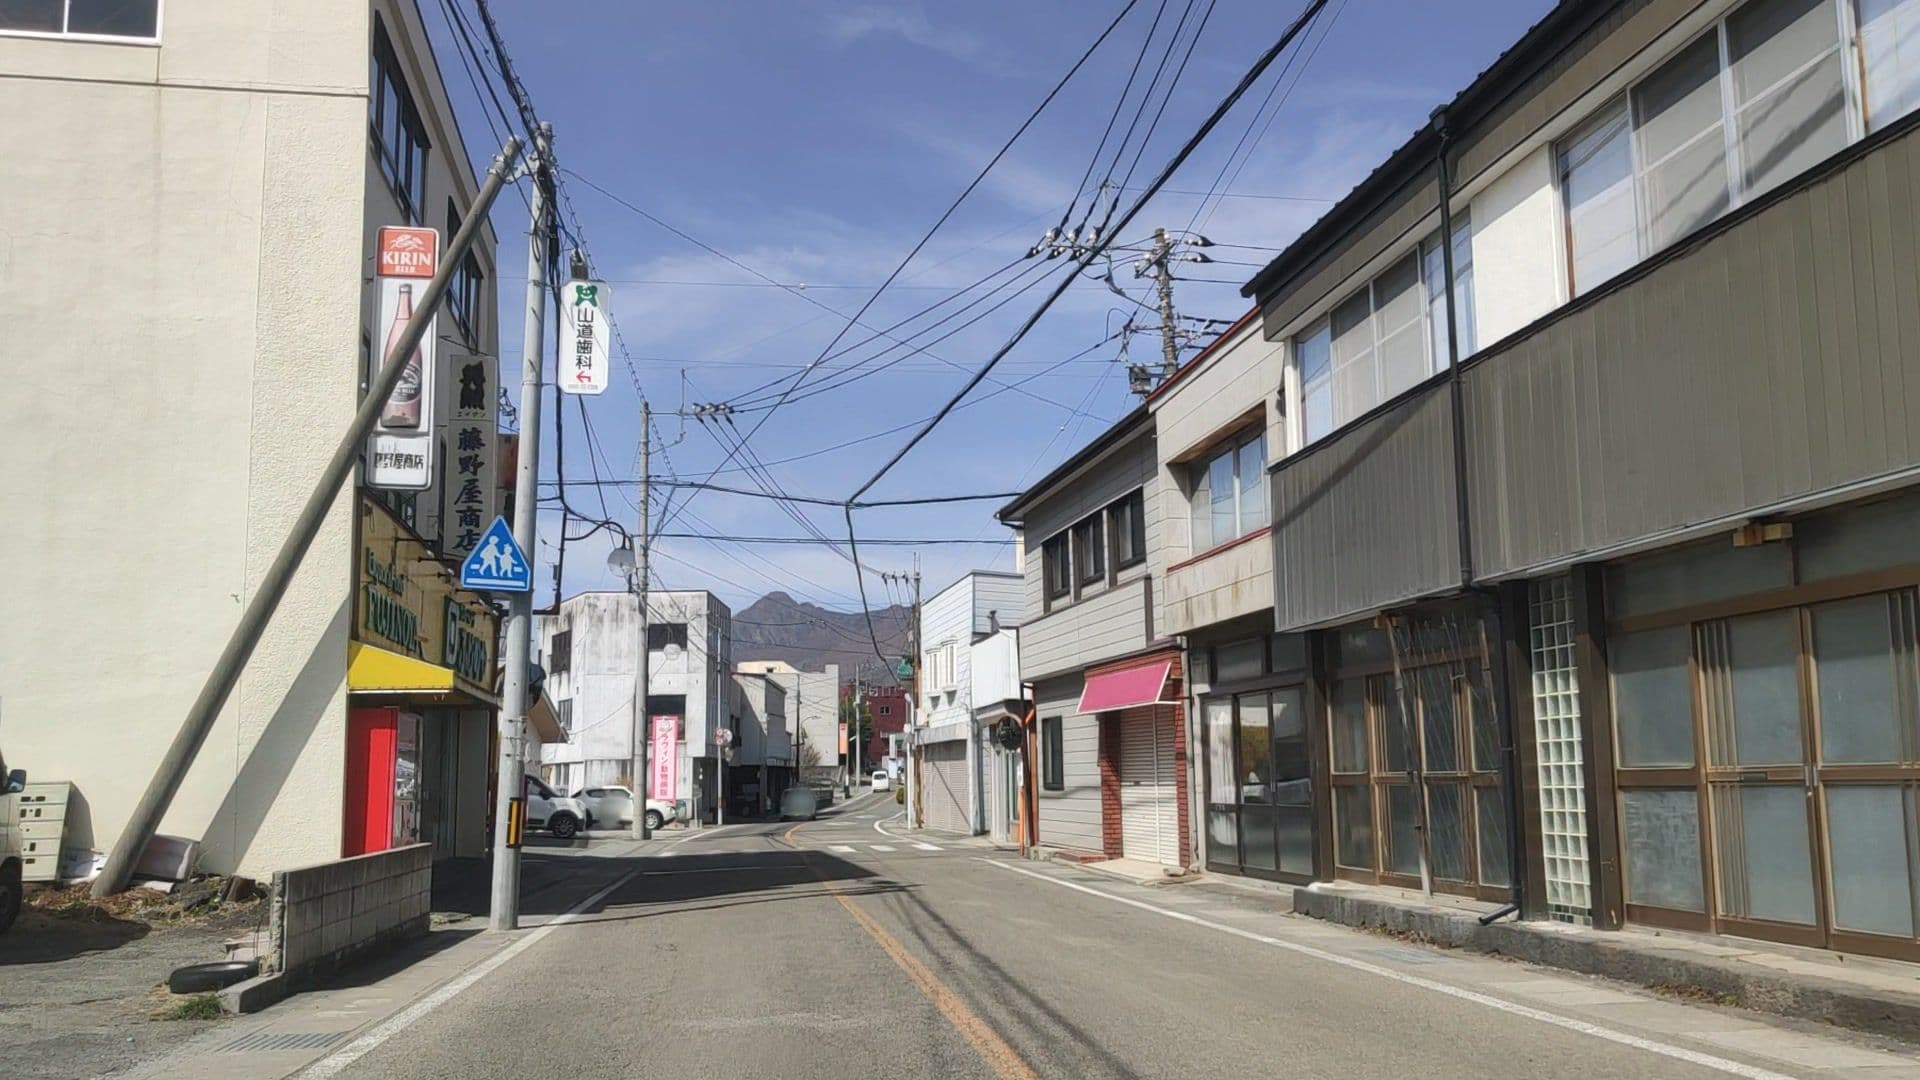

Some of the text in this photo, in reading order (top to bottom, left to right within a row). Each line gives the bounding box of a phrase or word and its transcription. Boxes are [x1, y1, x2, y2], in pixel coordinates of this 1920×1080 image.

[383, 251, 432, 265] KIRIN
[453, 427, 485, 552] 藤野屋商店
